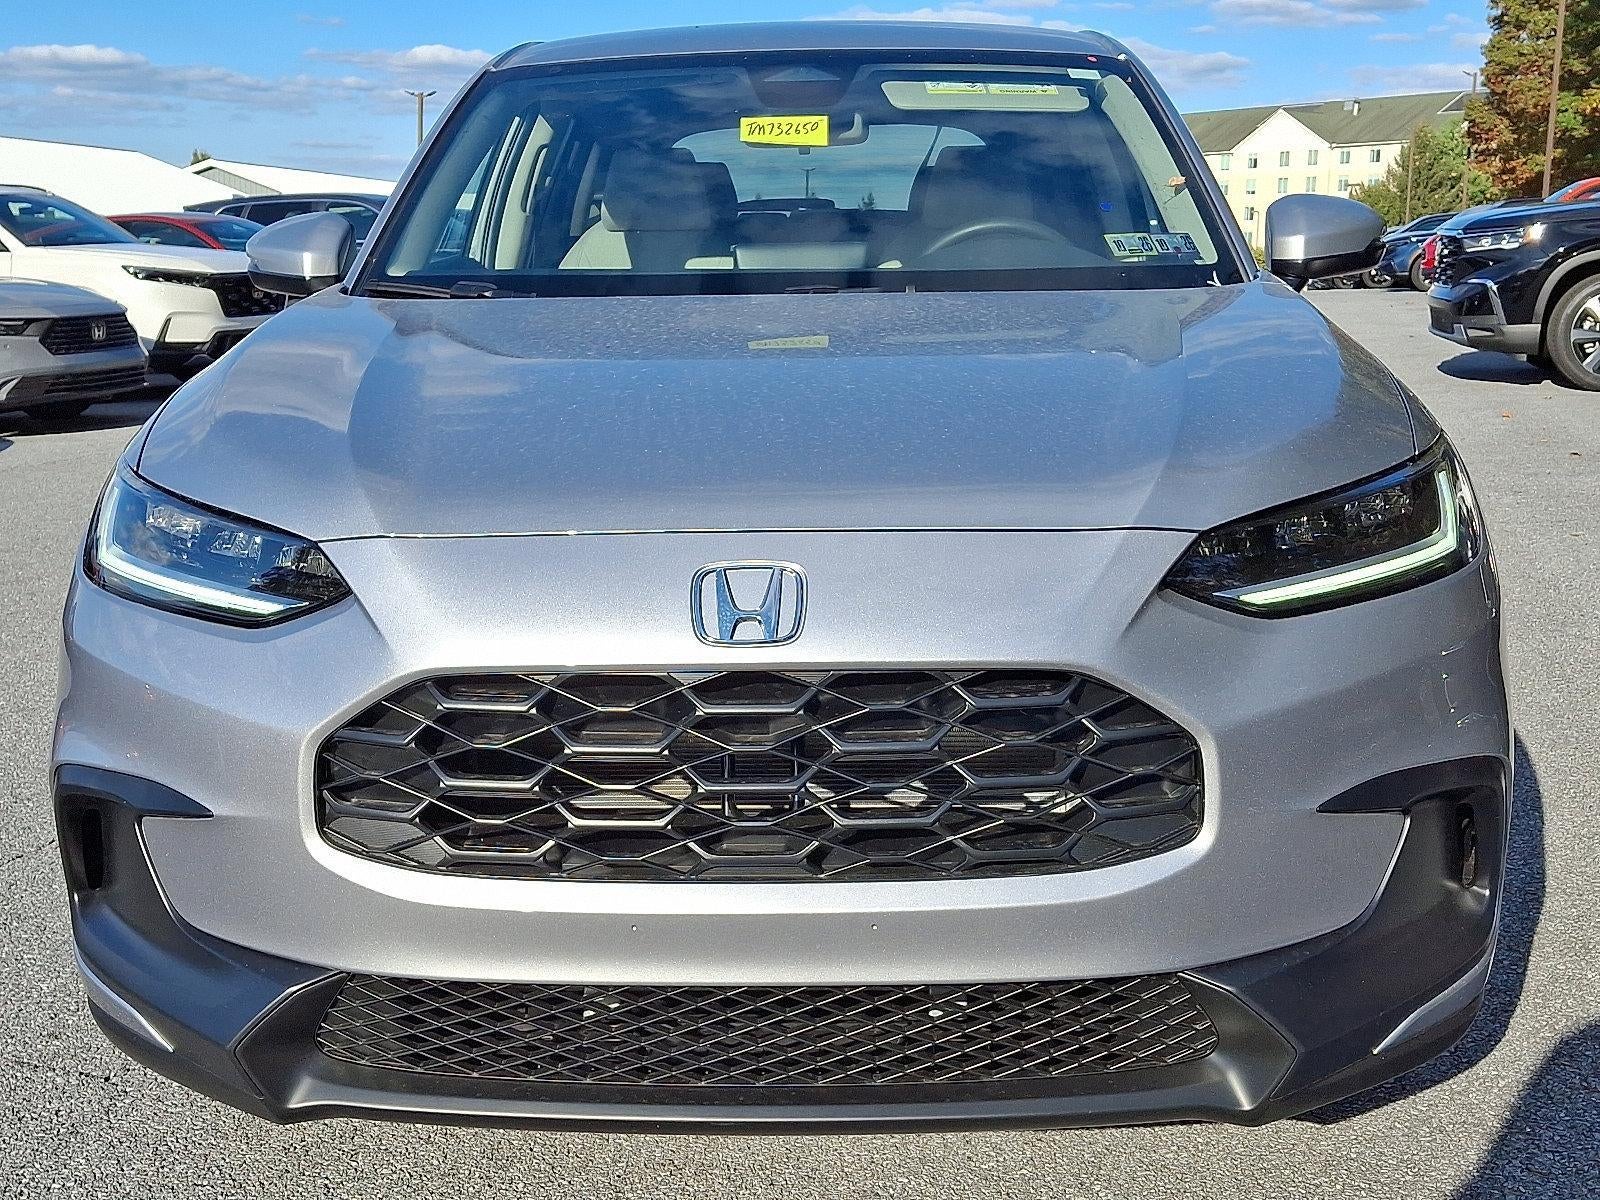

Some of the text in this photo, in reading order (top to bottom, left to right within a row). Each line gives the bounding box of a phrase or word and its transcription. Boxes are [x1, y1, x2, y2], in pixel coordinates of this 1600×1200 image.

[746, 121, 819, 137] TM732650
[1113, 239, 1128, 252] 10
[1156, 238, 1170, 252] 10
